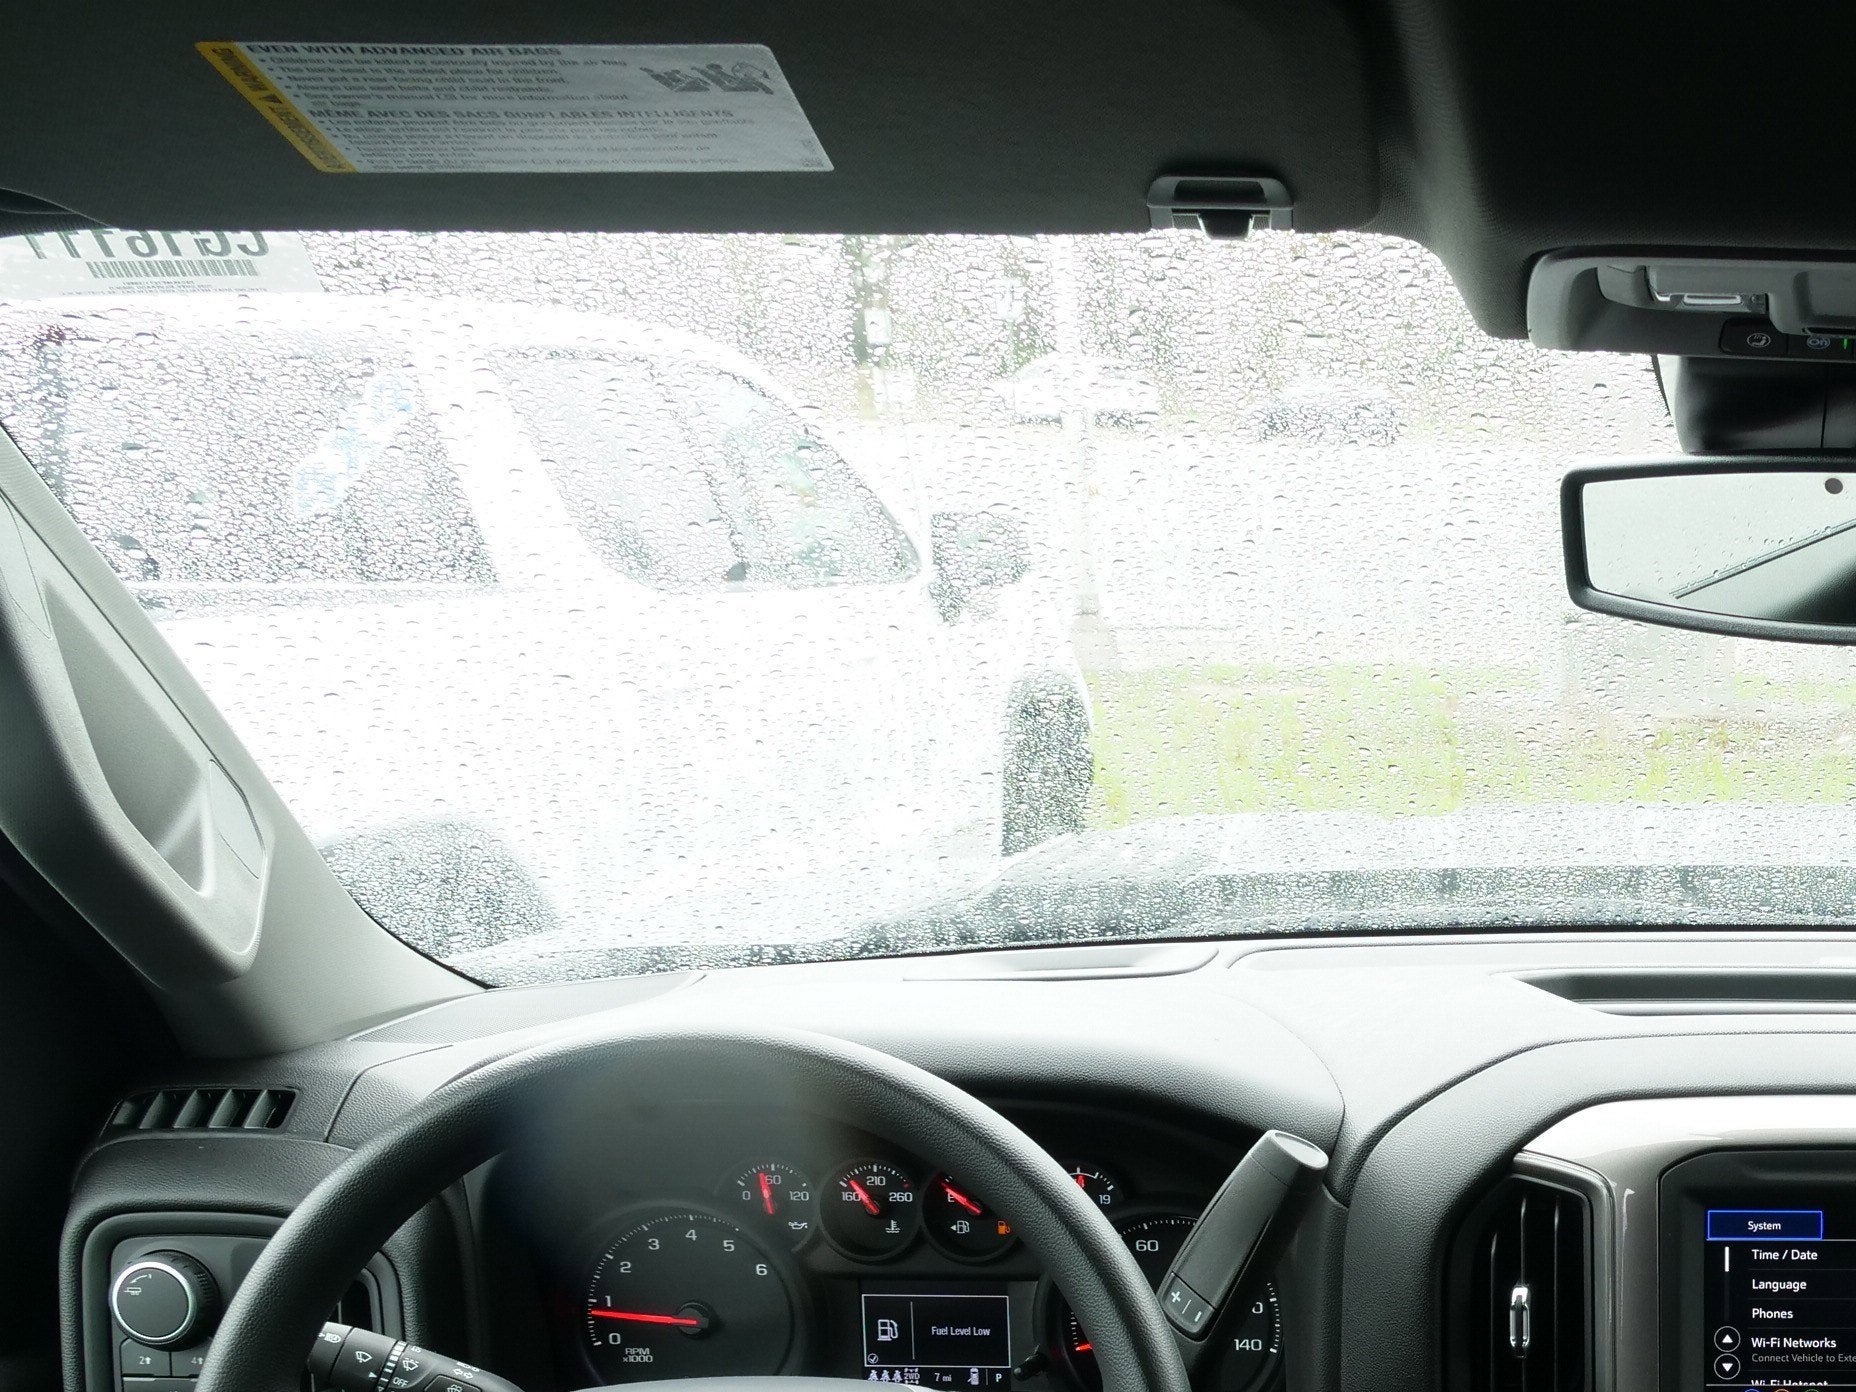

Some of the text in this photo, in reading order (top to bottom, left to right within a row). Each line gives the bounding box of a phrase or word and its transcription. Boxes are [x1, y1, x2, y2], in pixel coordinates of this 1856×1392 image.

[244, 44, 563, 55] EVEN WITH ADVANCED AIR BAGS
[765, 1175, 782, 1185] 60
[866, 1176, 886, 1186] 210
[742, 1191, 751, 1200] 0
[789, 1191, 809, 1201] 120
[842, 1191, 861, 1201] 160
[889, 1192, 913, 1202] 260
[1099, 1194, 1111, 1205] 19
[1747, 1220, 1782, 1232] System
[685, 1229, 697, 1241] 4
[648, 1238, 660, 1250] 3
[723, 1240, 735, 1252] 5
[1135, 1240, 1159, 1252] 60
[1751, 1249, 1818, 1262] Time / Date
[620, 1261, 632, 1273] 2
[756, 1264, 768, 1276] 6
[1752, 1279, 1808, 1293] Language
[605, 1295, 611, 1307] 1
[1752, 1308, 1794, 1319] Phones
[931, 1326, 991, 1336] Fuel Level Low
[608, 1333, 621, 1345] 0
[1750, 1337, 1837, 1348] Wi-Fi Networks
[1234, 1339, 1263, 1351] 140
[622, 1355, 654, 1363] x1000
[1751, 1353, 1790, 1362] Connect
[1791, 1353, 1824, 1362] Vehicle
[393, 1377, 410, 1388] OFF
[934, 1373, 952, 1382] 7 mi
[995, 1373, 1002, 1382] P
